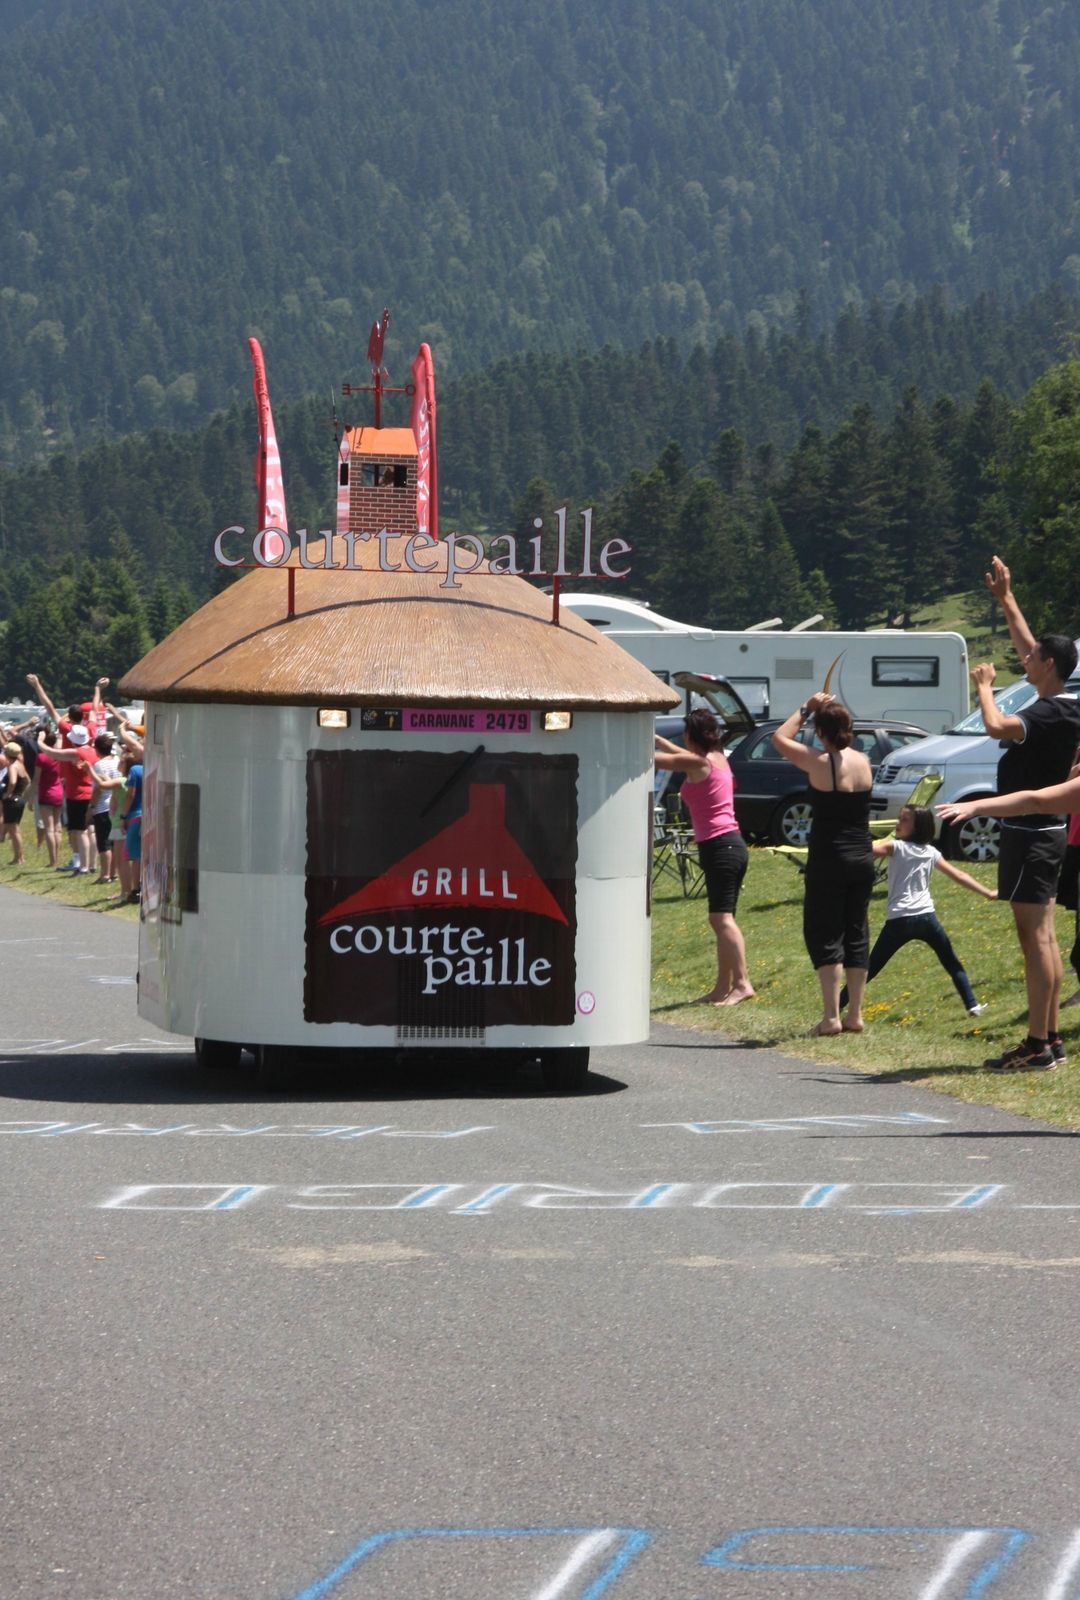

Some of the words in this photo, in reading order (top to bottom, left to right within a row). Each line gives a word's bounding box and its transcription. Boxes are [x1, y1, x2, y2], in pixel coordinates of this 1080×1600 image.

[214, 507, 632, 588] courtepaille
[410, 713, 475, 729] CARAVANE
[486, 713, 528, 730] 2479
[411, 867, 518, 900] GRILL
[329, 922, 485, 956] courte
[422, 938, 552, 994] paille
